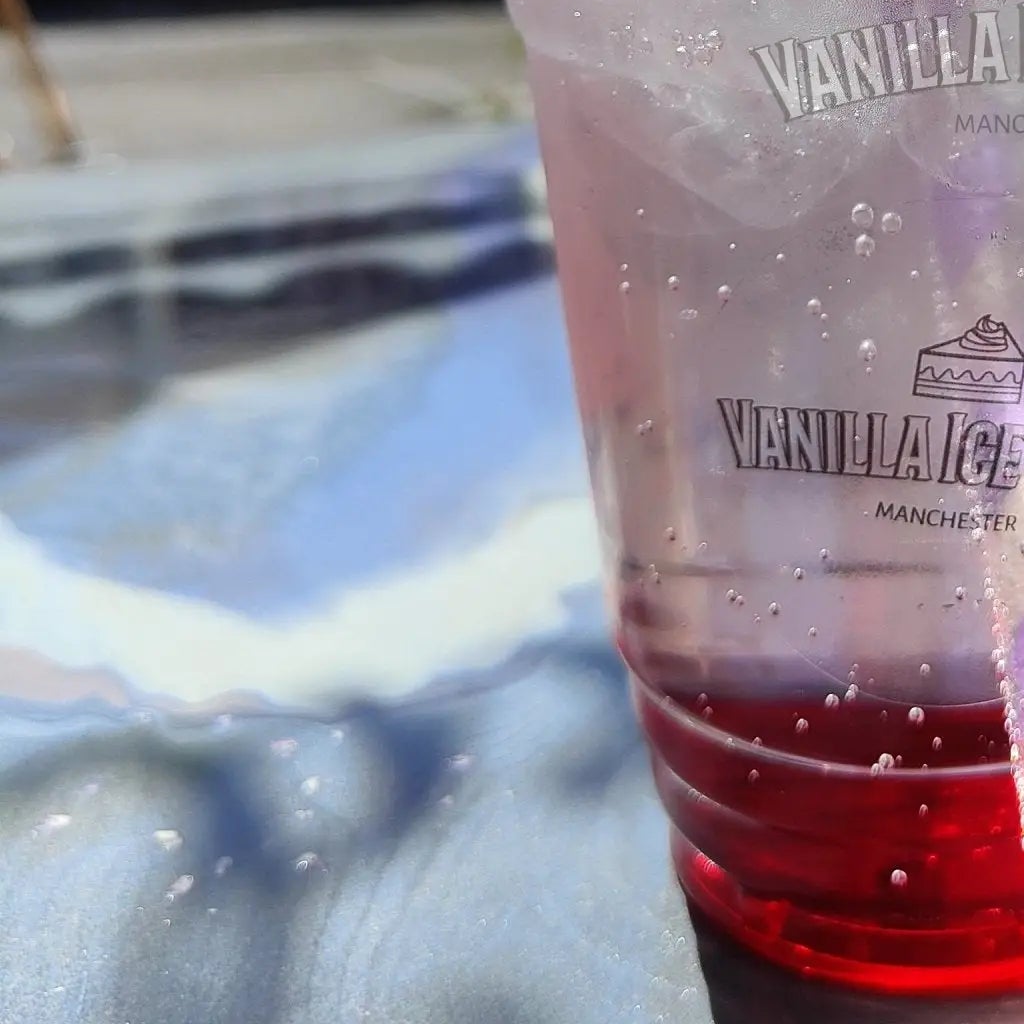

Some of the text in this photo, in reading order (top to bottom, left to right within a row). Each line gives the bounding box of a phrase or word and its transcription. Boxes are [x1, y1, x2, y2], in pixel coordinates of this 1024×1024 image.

[748, 10, 1008, 123] VANILLA
[717, 398, 932, 482] VANILLA
[874, 501, 1018, 533] MANCHESTER
